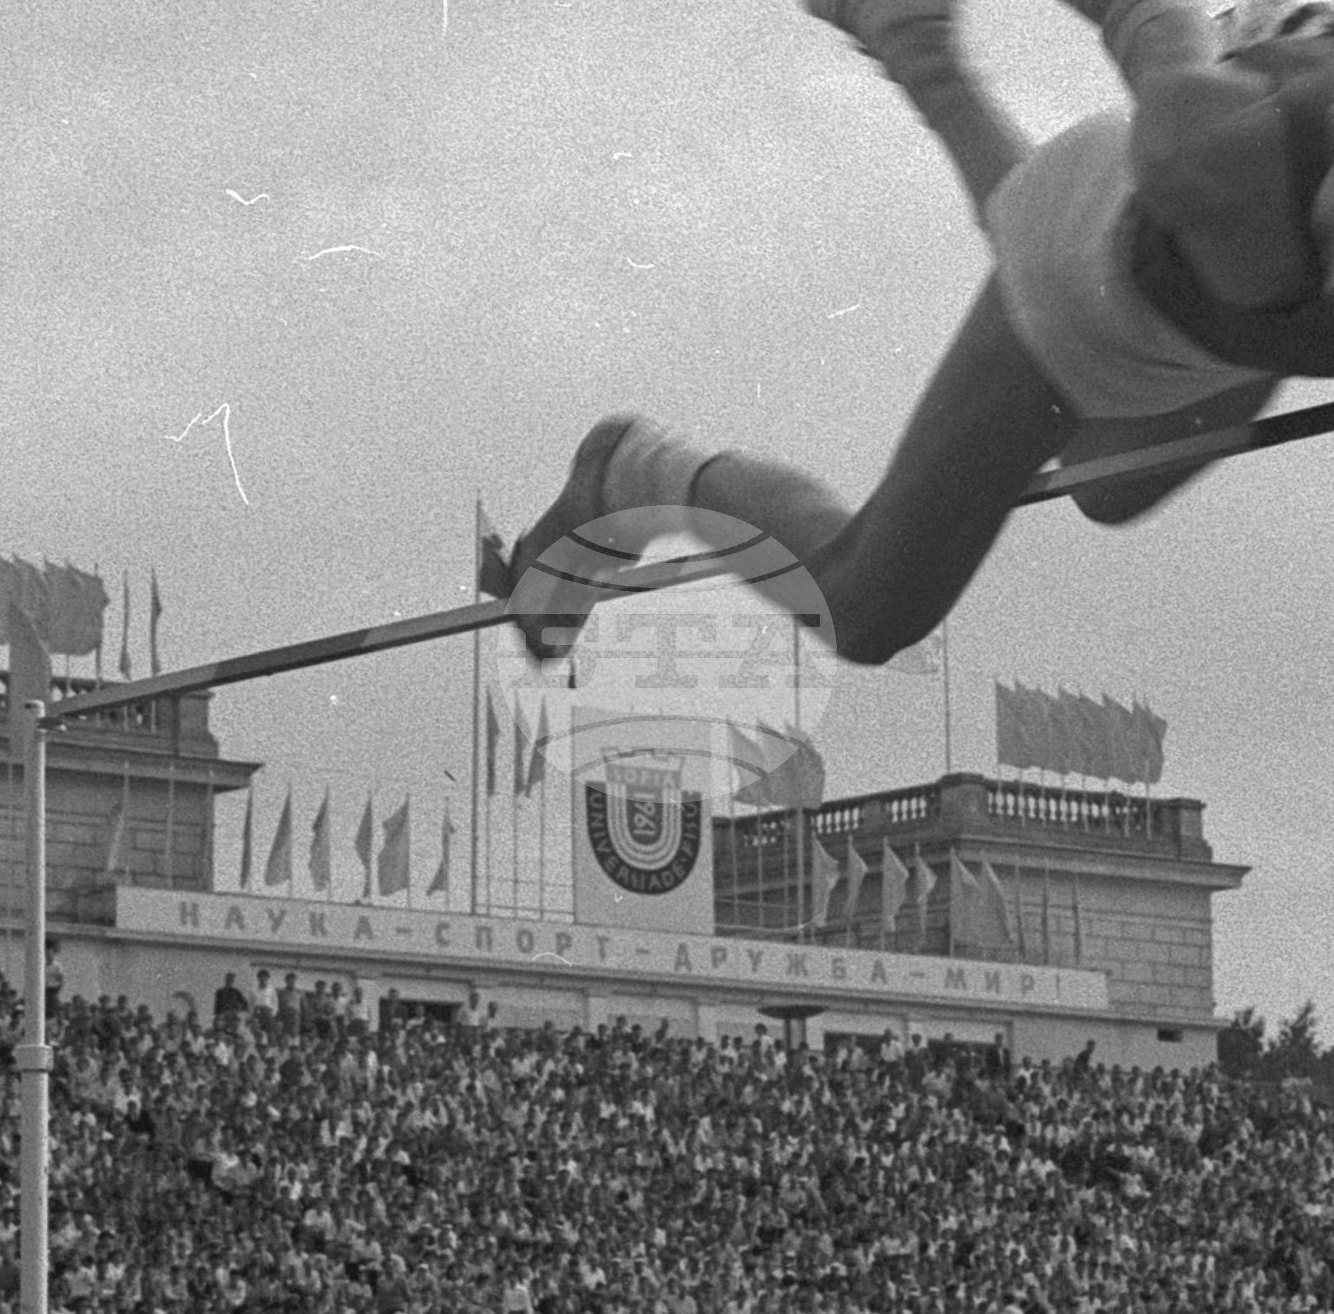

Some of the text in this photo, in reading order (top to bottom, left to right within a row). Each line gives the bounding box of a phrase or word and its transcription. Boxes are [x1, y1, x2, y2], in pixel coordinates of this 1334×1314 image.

[632, 792, 656, 836] 1961
[178, 900, 374, 941] НАУКА
[434, 921, 611, 961] СПОРТ
[673, 942, 888, 985] ДРУЖБА
